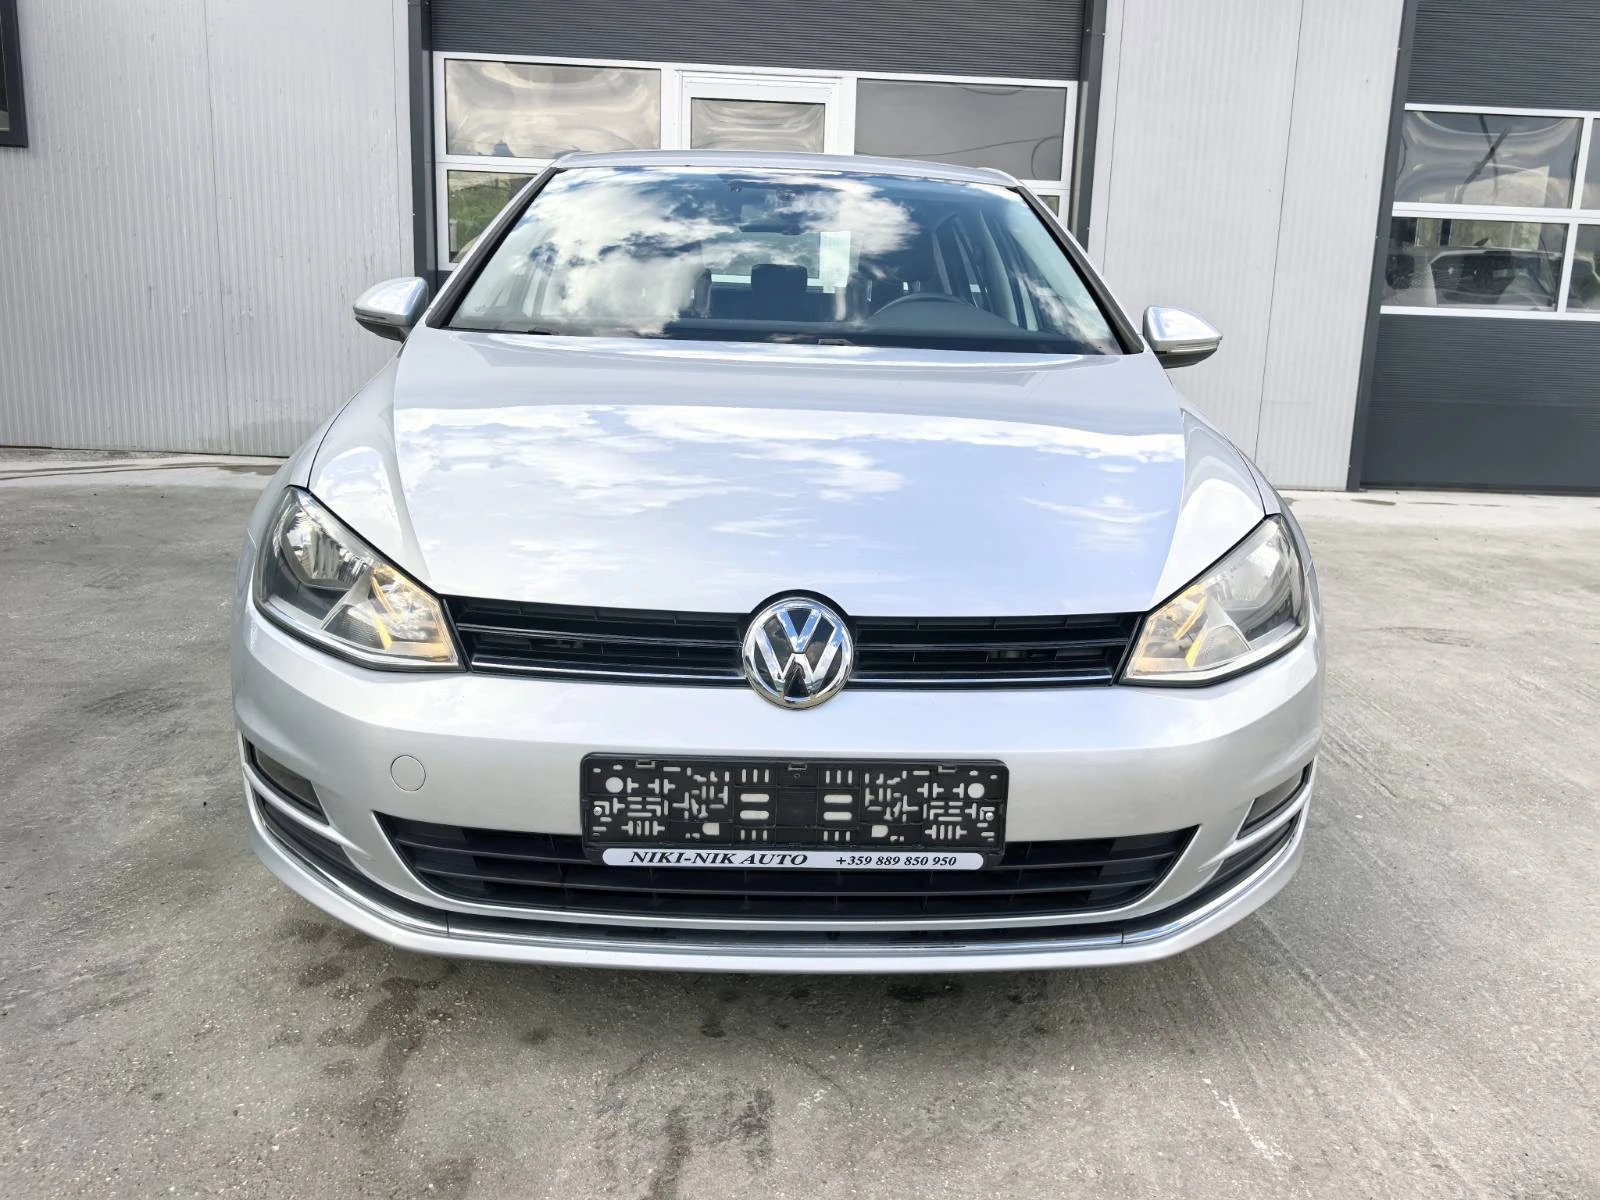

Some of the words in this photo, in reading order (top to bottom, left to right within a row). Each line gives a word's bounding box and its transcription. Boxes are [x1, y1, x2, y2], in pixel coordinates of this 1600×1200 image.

[628, 851, 737, 865] NIKI-NIK
[739, 853, 809, 866] AUTO
[835, 855, 873, 867] +359
[875, 855, 901, 867] 889
[903, 856, 929, 867] 850
[931, 856, 957, 867] 950
